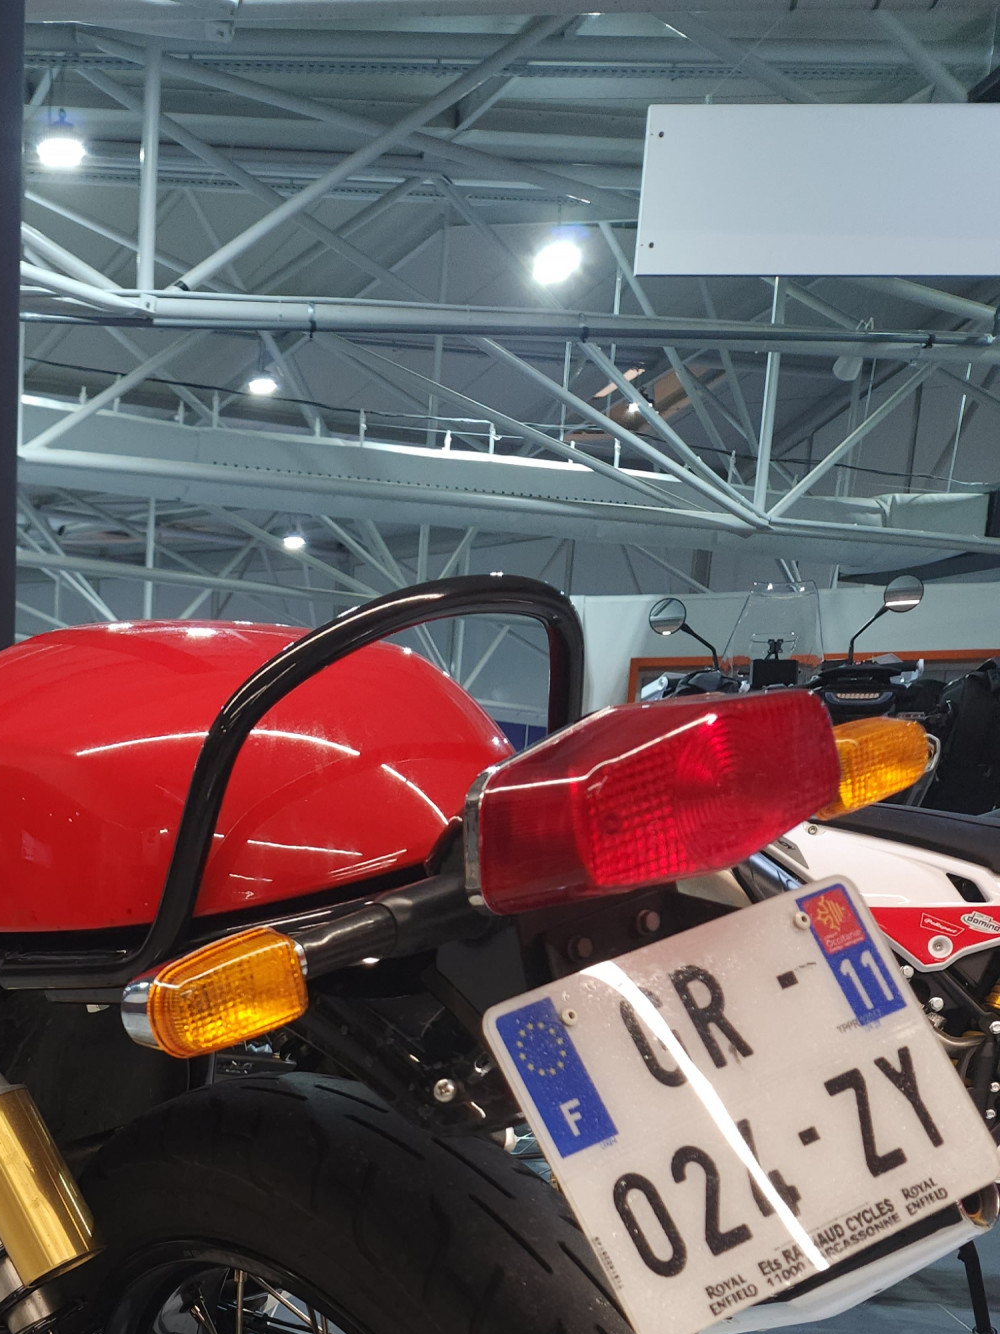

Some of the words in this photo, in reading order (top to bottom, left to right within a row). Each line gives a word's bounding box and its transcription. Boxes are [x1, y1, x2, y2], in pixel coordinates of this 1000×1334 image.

[840, 949, 895, 1010] 11
[559, 1098, 583, 1138] F
[901, 1177, 938, 1200] ROYAL
[906, 1187, 949, 1217] ENFIELD
[757, 1257, 783, 1276] Ets
[847, 1198, 895, 1231] CYCLES
[704, 1273, 748, 1298] ROYAL
[709, 1284, 759, 1317] ENFIELD
